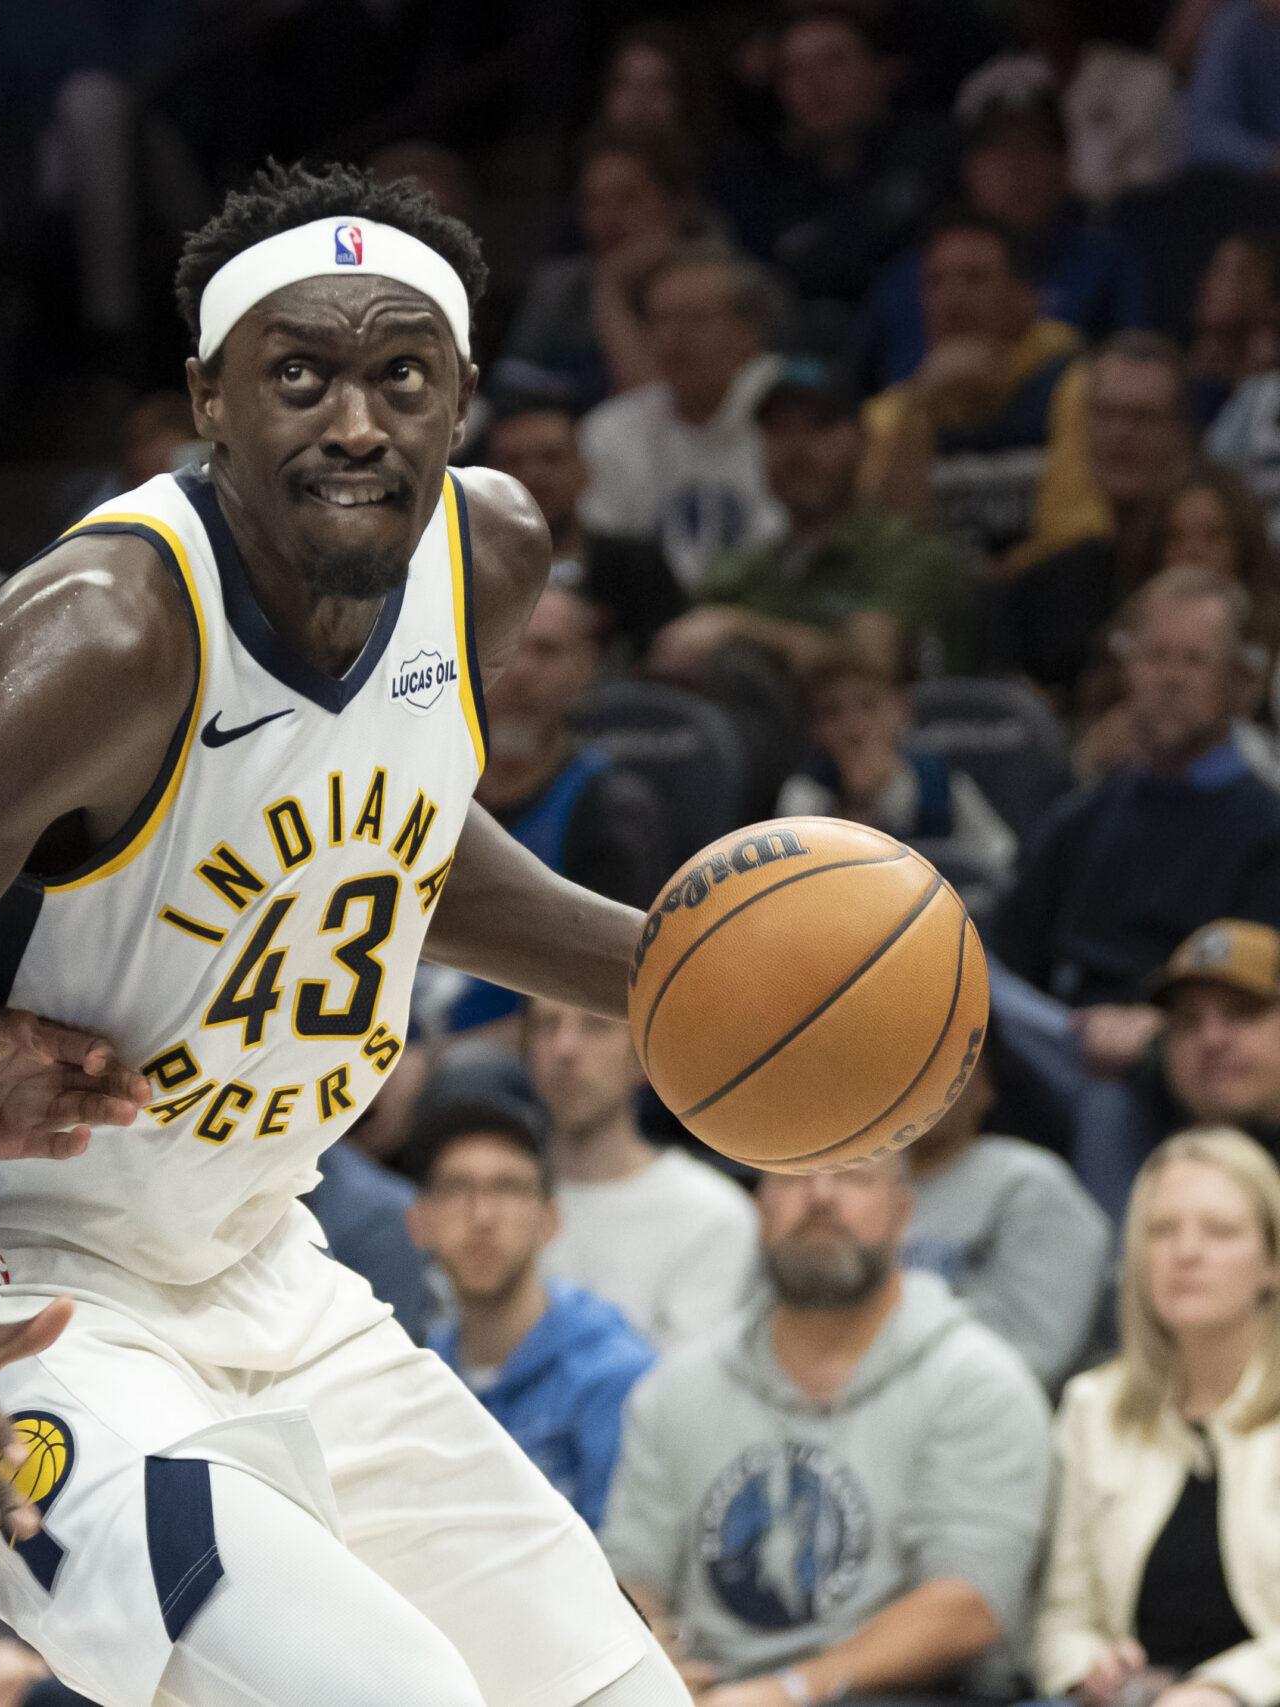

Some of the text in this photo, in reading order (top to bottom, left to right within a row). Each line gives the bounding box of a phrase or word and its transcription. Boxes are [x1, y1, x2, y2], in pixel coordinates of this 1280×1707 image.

[391, 660, 457, 698] LUCAS OIL
[158, 766, 456, 946] INDIANA
[629, 828, 811, 991] Wilson
[200, 869, 402, 1051] 43
[140, 1021, 405, 1146] PACERS
